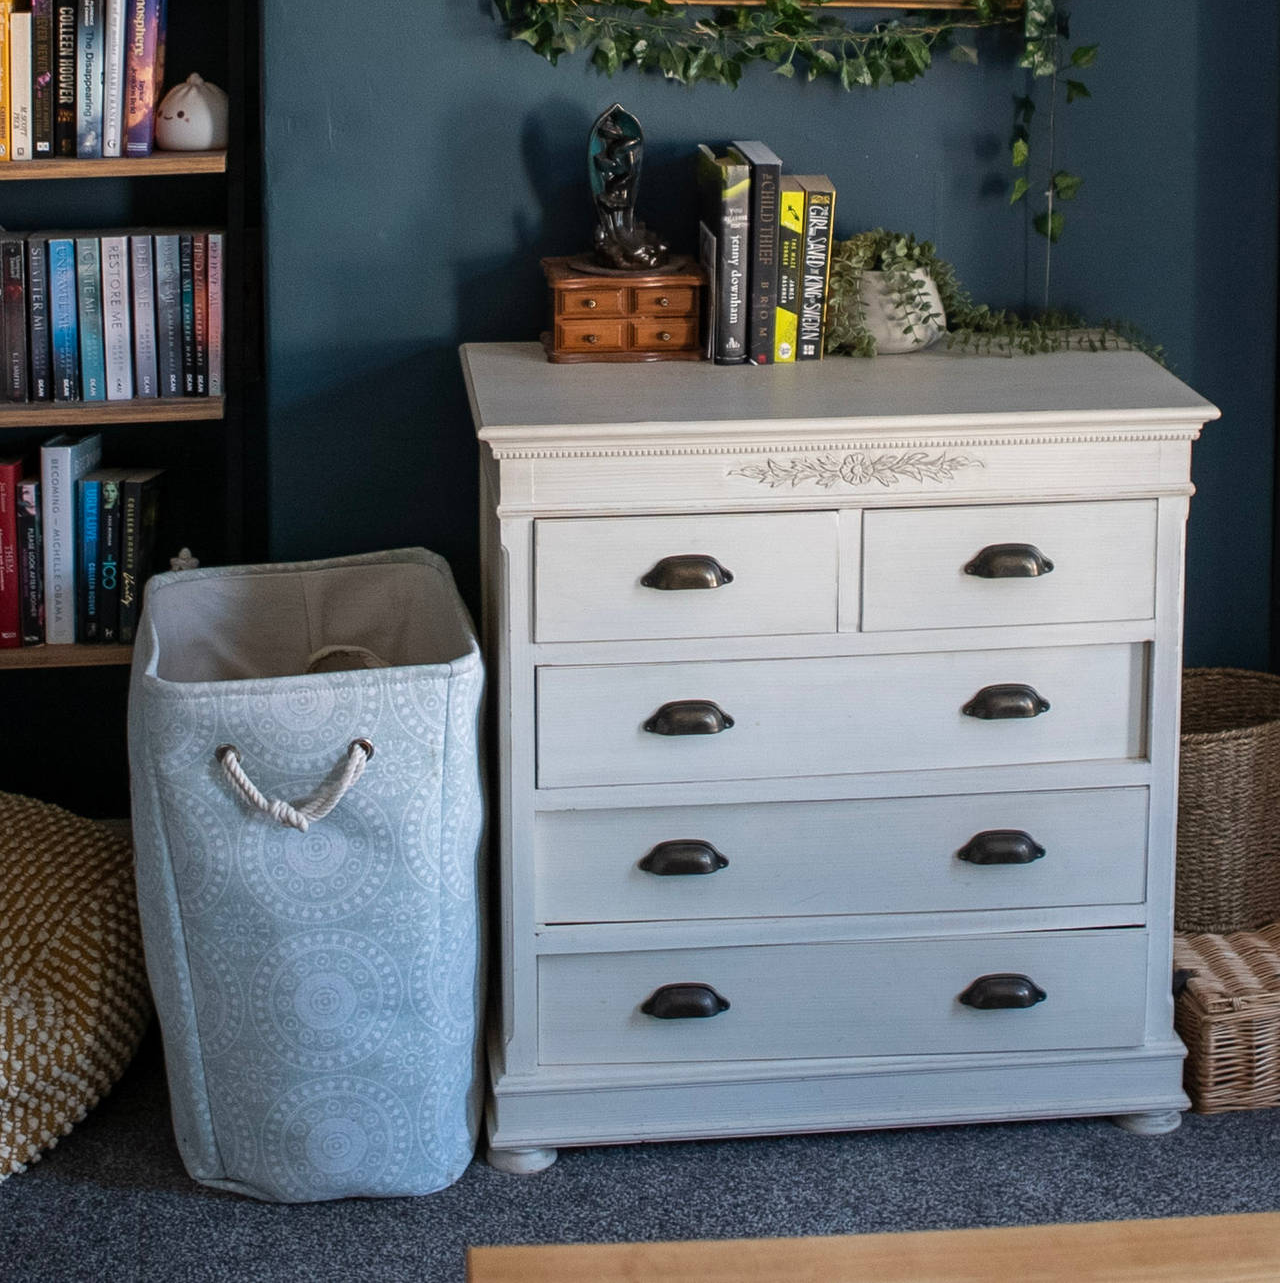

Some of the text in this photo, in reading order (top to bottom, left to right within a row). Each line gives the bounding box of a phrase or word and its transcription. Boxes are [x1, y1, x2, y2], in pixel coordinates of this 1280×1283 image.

[59, 6, 74, 104] COLLEEN HOOVER
[82, 31, 95, 117] The Disappearing
[759, 181, 775, 266] CHILD THIEF
[809, 205, 827, 230] GIRL
[31, 247, 42, 311] SHATTER
[82, 245, 96, 294] IGNITE
[136, 244, 150, 308] DEFY ME
[728, 235, 743, 324] jenny downham
[806, 236, 827, 267] SAVED
[108, 245, 122, 329] RESTORE ME
[804, 275, 825, 299] KING
[801, 303, 822, 340] SWEDEN
[51, 458, 63, 623] BECOMING MICHELLE OBAMA
[86, 489, 98, 541] UGLY LOVE
[127, 497, 136, 569] COLLEEN HOOVER
[5, 544, 14, 573] THEM
[27, 527, 37, 589] PLEASE LOOK AFTER
[102, 561, 117, 590] 100
[121, 571, 135, 607] Verity
